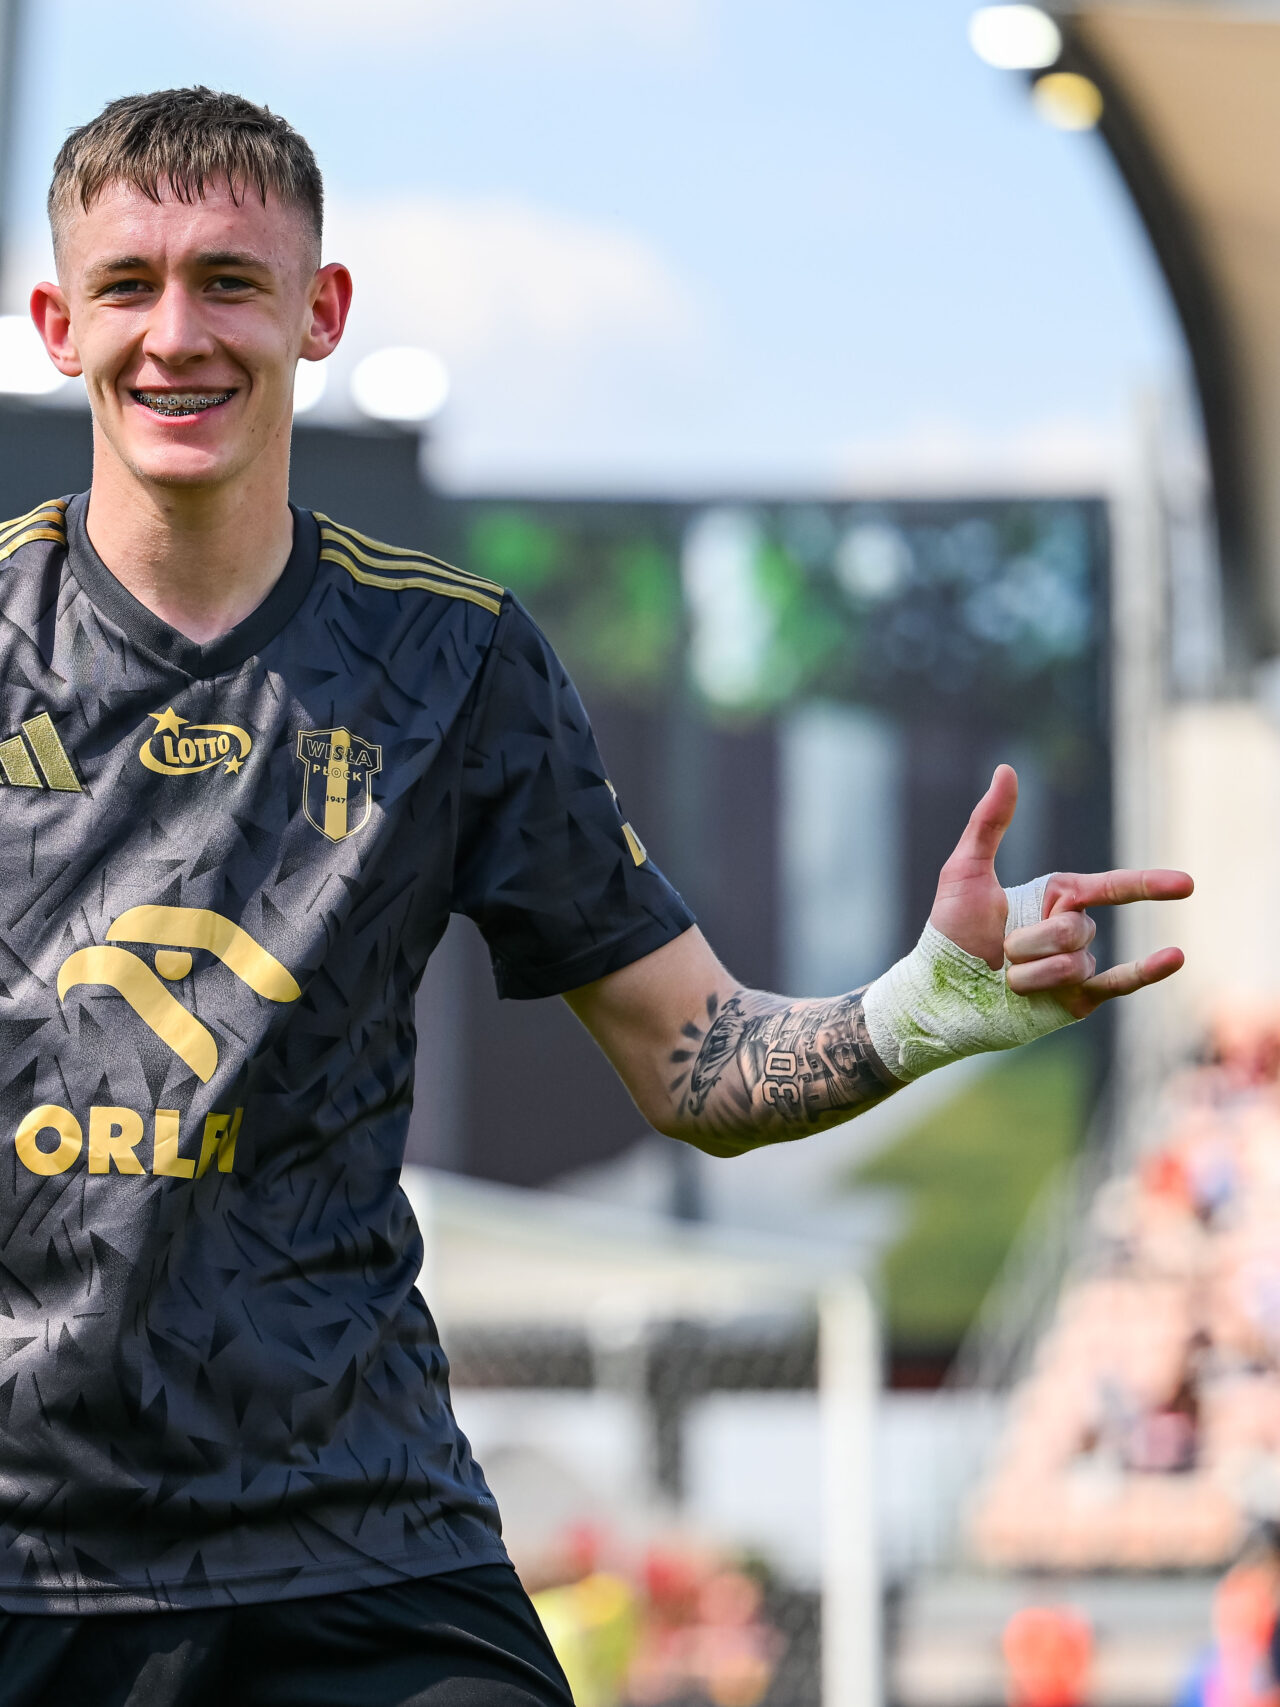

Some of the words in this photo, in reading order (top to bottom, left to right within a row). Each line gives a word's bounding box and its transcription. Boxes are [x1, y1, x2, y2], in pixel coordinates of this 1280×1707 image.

[163, 734, 230, 764] LOTTO
[306, 739, 373, 767] WISŁA
[313, 764, 362, 782] PŁOCK
[326, 795, 346, 804] 1947
